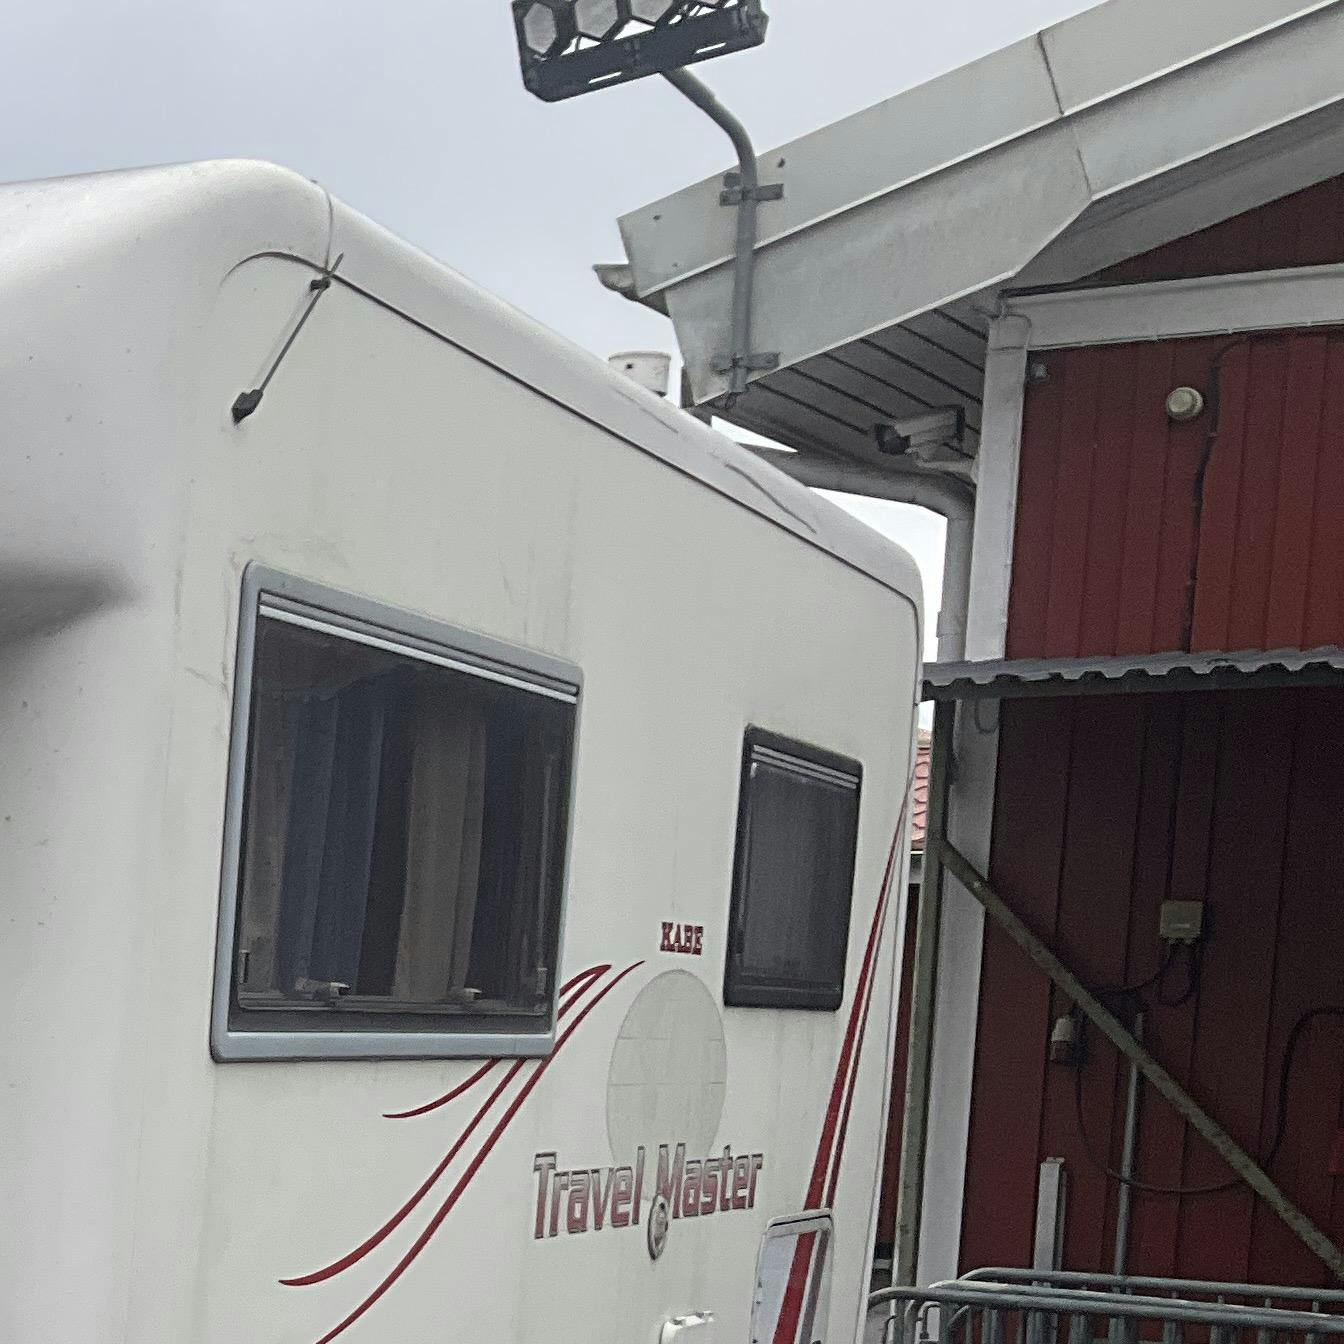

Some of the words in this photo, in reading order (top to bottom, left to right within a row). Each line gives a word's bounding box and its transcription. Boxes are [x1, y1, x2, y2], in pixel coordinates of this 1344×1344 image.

[660, 921, 703, 956] KABE
[533, 1145, 646, 1239] Travel
[655, 1142, 763, 1219] Master
